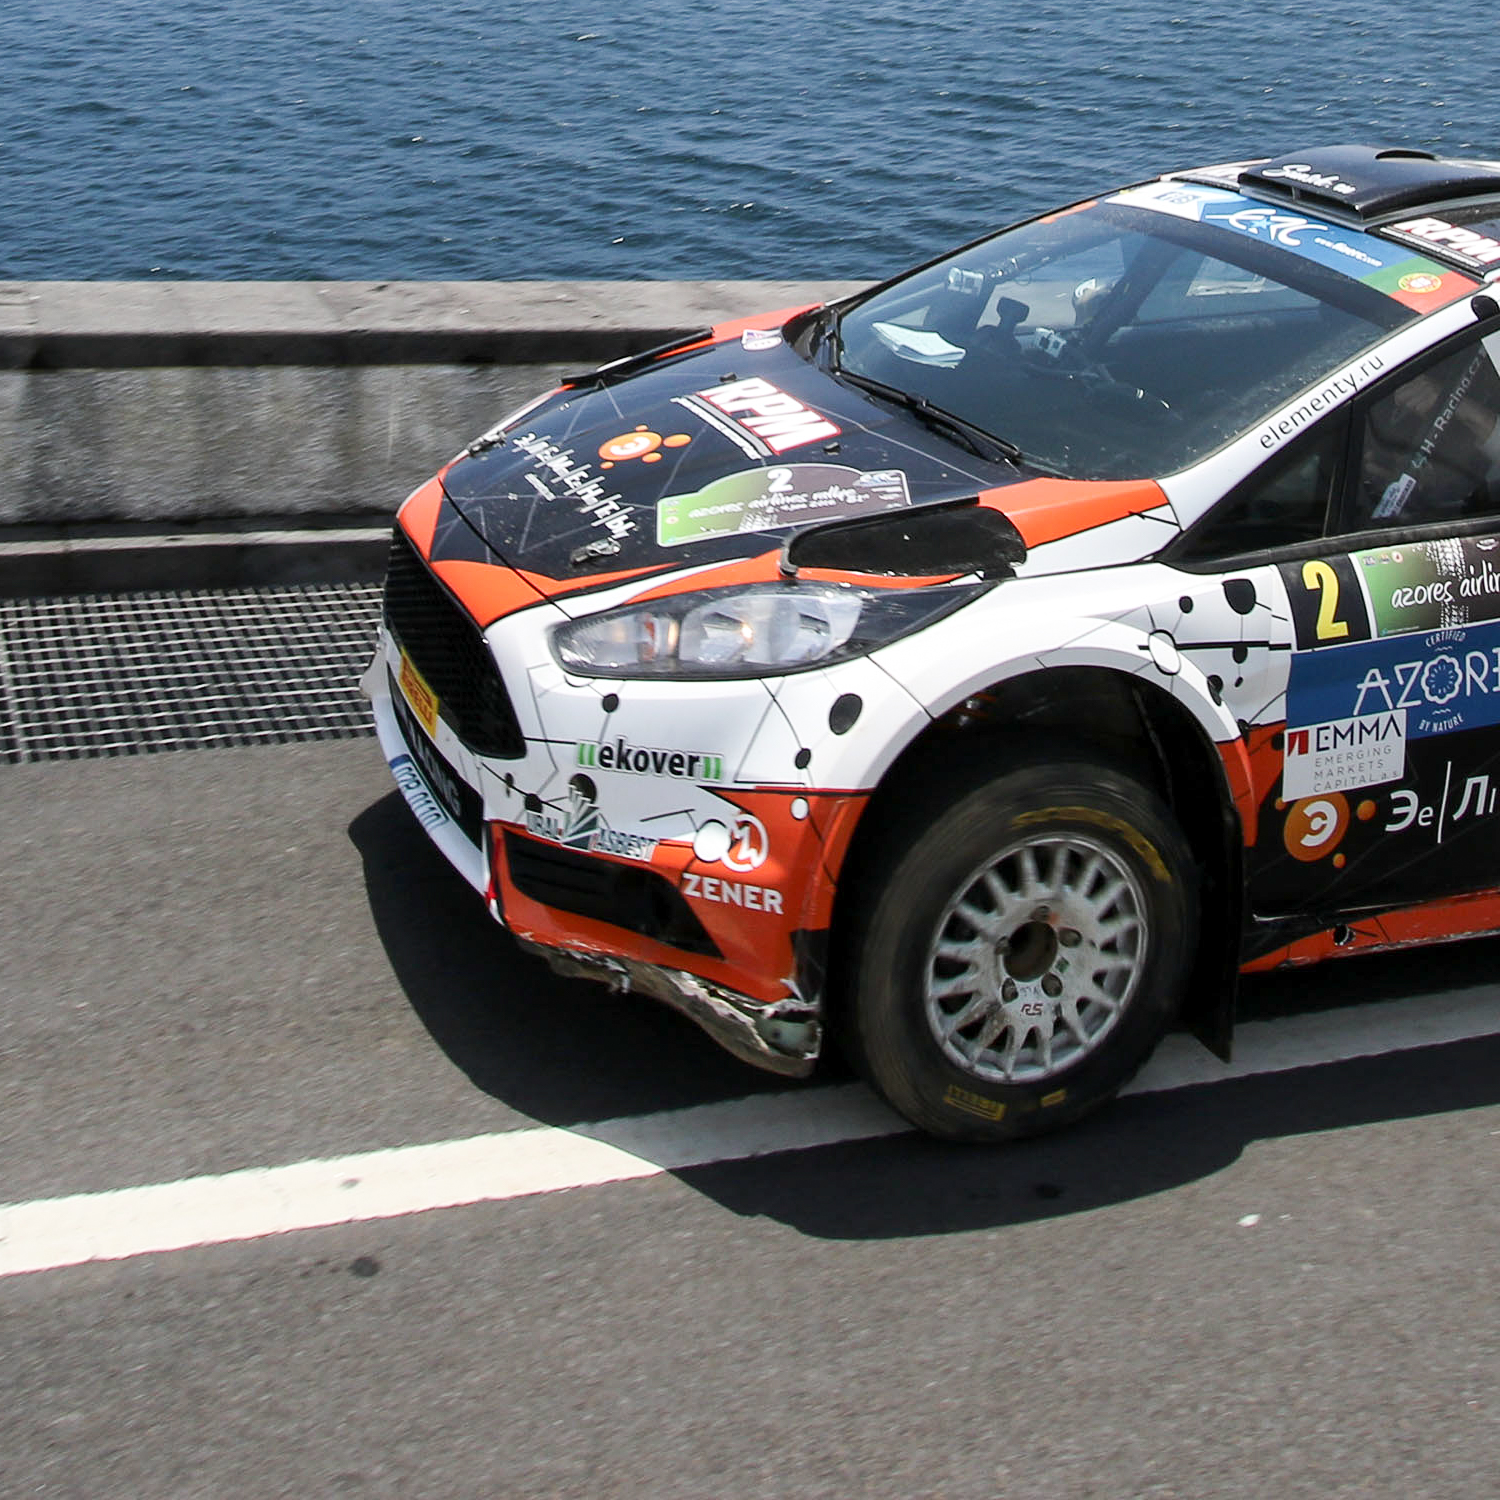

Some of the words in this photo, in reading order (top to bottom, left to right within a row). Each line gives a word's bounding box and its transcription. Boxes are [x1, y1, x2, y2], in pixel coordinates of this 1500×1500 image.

[695, 377, 842, 455] RPM
[1260, 354, 1384, 450] elementy.ru
[767, 468, 794, 493] 2
[1301, 559, 1349, 640] 2
[1391, 579, 1453, 609] azores
[1425, 630, 1467, 648] CERTIFIED
[1316, 713, 1402, 752] EMMA
[1432, 711, 1464, 733] NATURE
[599, 738, 700, 777] ekover
[1314, 759, 1384, 780] MARKETS
[1315, 744, 1392, 768] EMERGING
[1313, 773, 1376, 793] CAPITAL
[681, 872, 785, 915] ZENER
